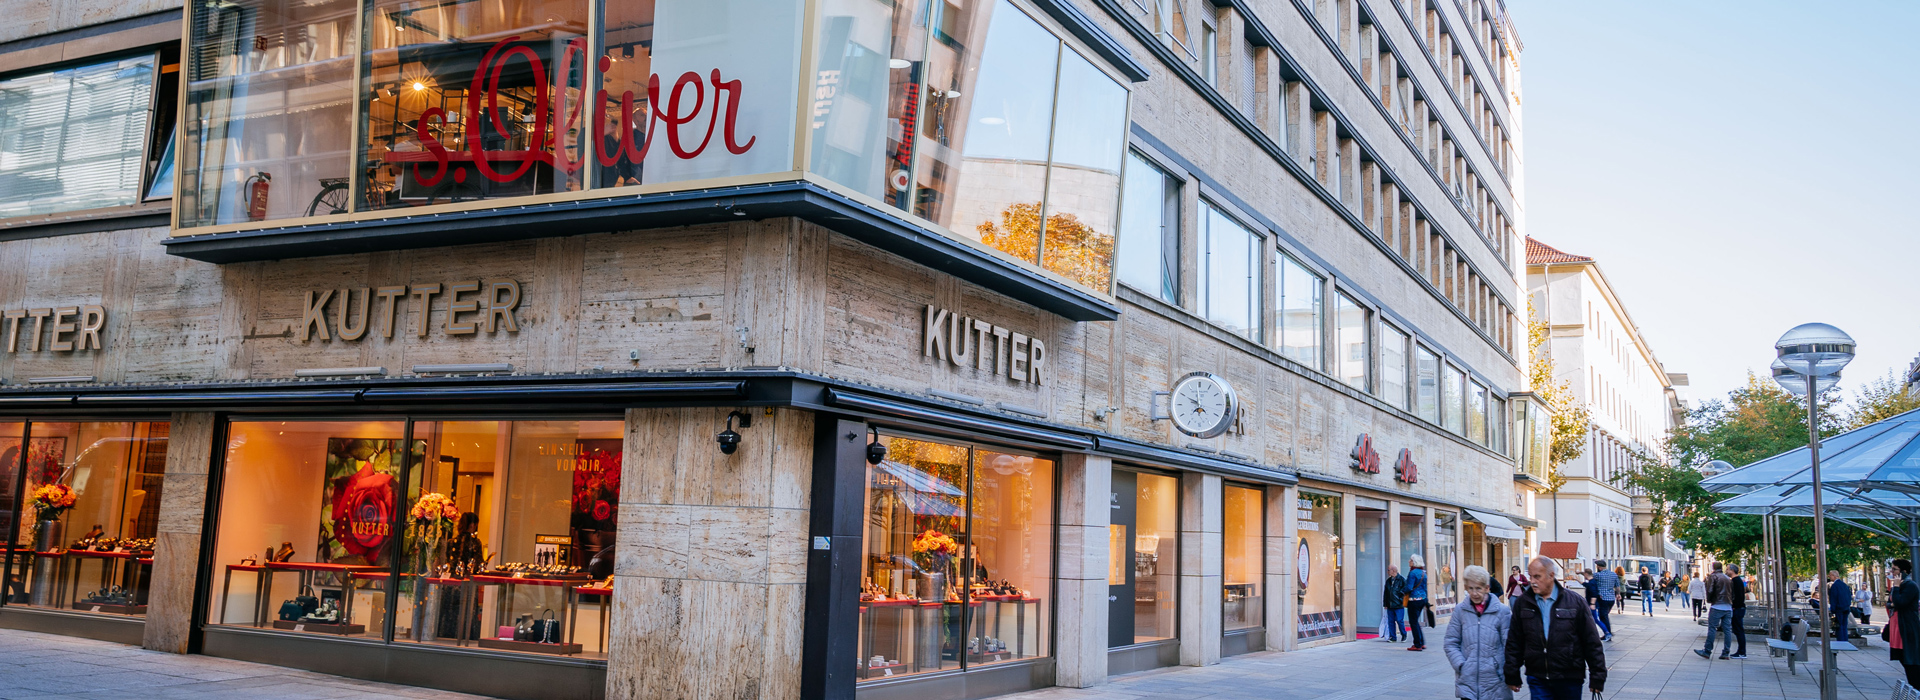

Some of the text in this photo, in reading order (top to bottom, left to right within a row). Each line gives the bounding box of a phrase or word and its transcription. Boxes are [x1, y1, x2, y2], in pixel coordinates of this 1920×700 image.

[412, 35, 756, 187] s.Oliver
[0, 304, 105, 353] TTER
[301, 279, 522, 341] KUTTER
[924, 304, 1046, 386] KUTTER
[540, 443, 585, 455] EIN TEIL
[557, 459, 577, 471] VON
[352, 521, 389, 536] KUTTER
